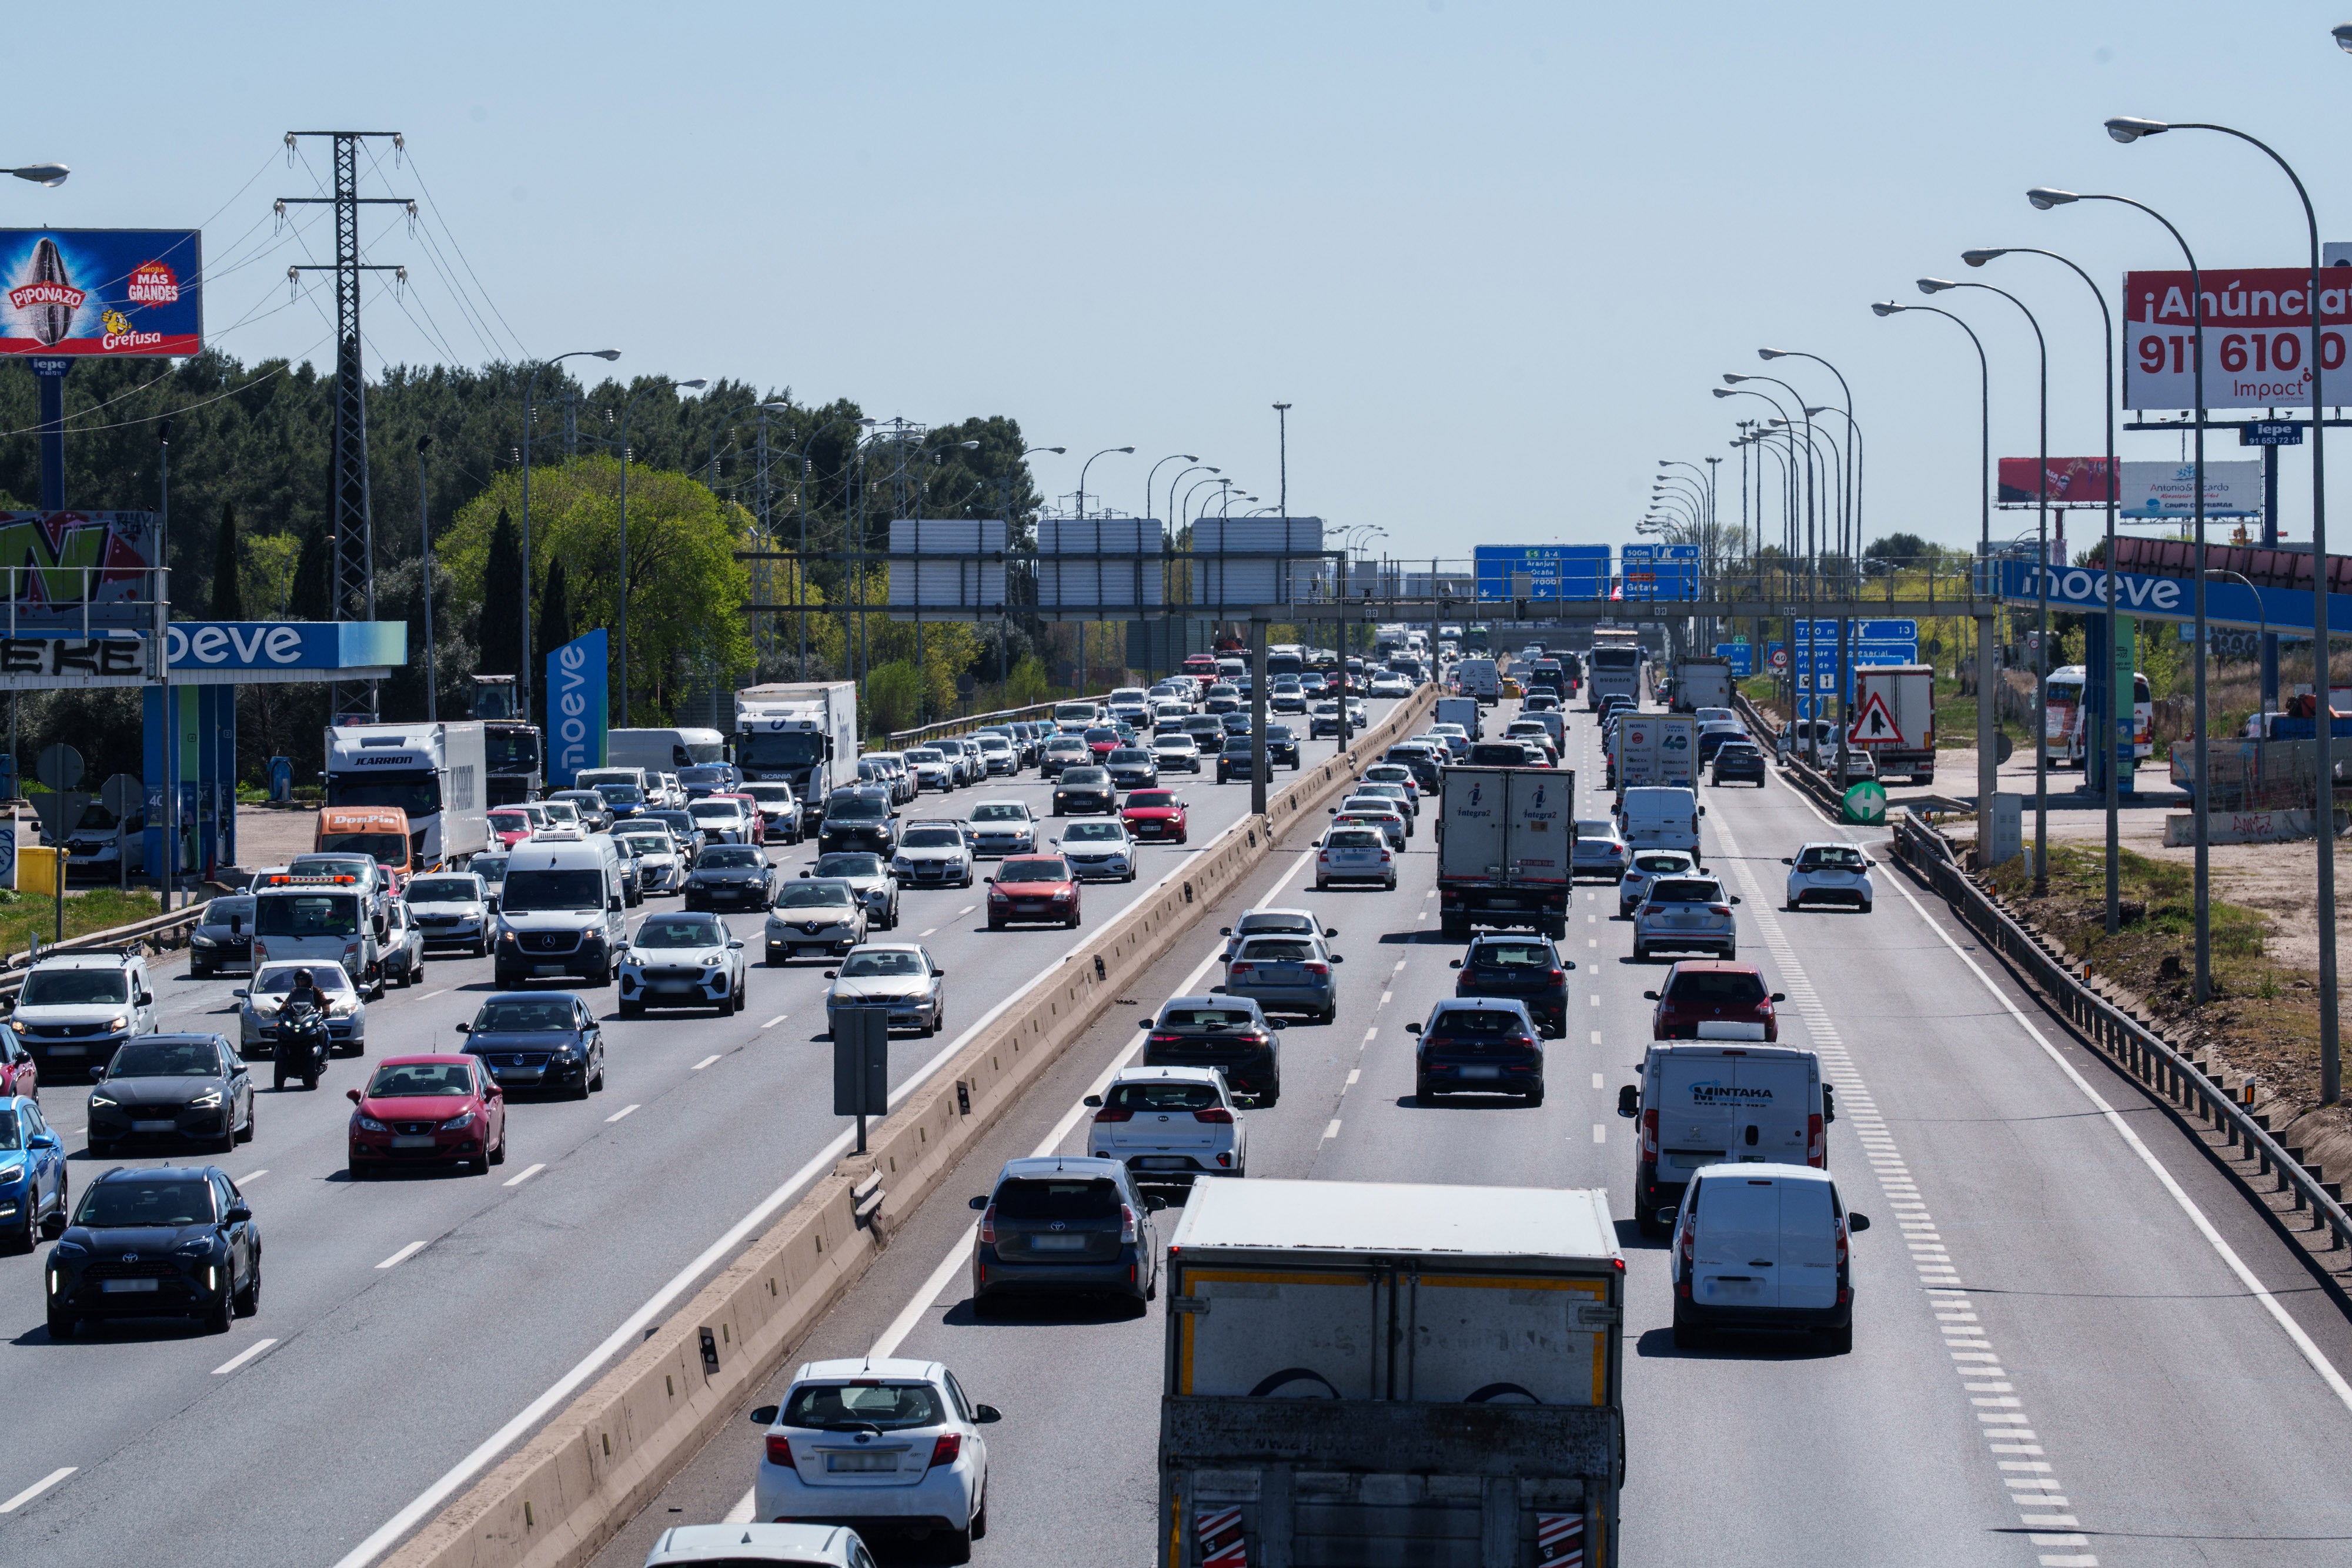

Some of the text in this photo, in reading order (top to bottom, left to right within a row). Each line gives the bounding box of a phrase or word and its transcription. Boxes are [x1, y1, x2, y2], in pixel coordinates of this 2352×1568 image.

[138, 271, 169, 285] MÁS
[128, 285, 178, 302] GRANDES
[102, 331, 161, 350] Grefusa
[2220, 332, 2301, 373] 610
[34, 358, 66, 371] iepe
[2234, 379, 2304, 401] Impact
[2257, 424, 2292, 437] iepe
[2022, 567, 2181, 609] moeve
[1898, 626, 1910, 634] 13
[560, 645, 586, 775] moeve
[1662, 735, 1688, 750] 40
[354, 755, 413, 766] JCARRION
[1694, 1086, 1773, 1101] MINTAKA
